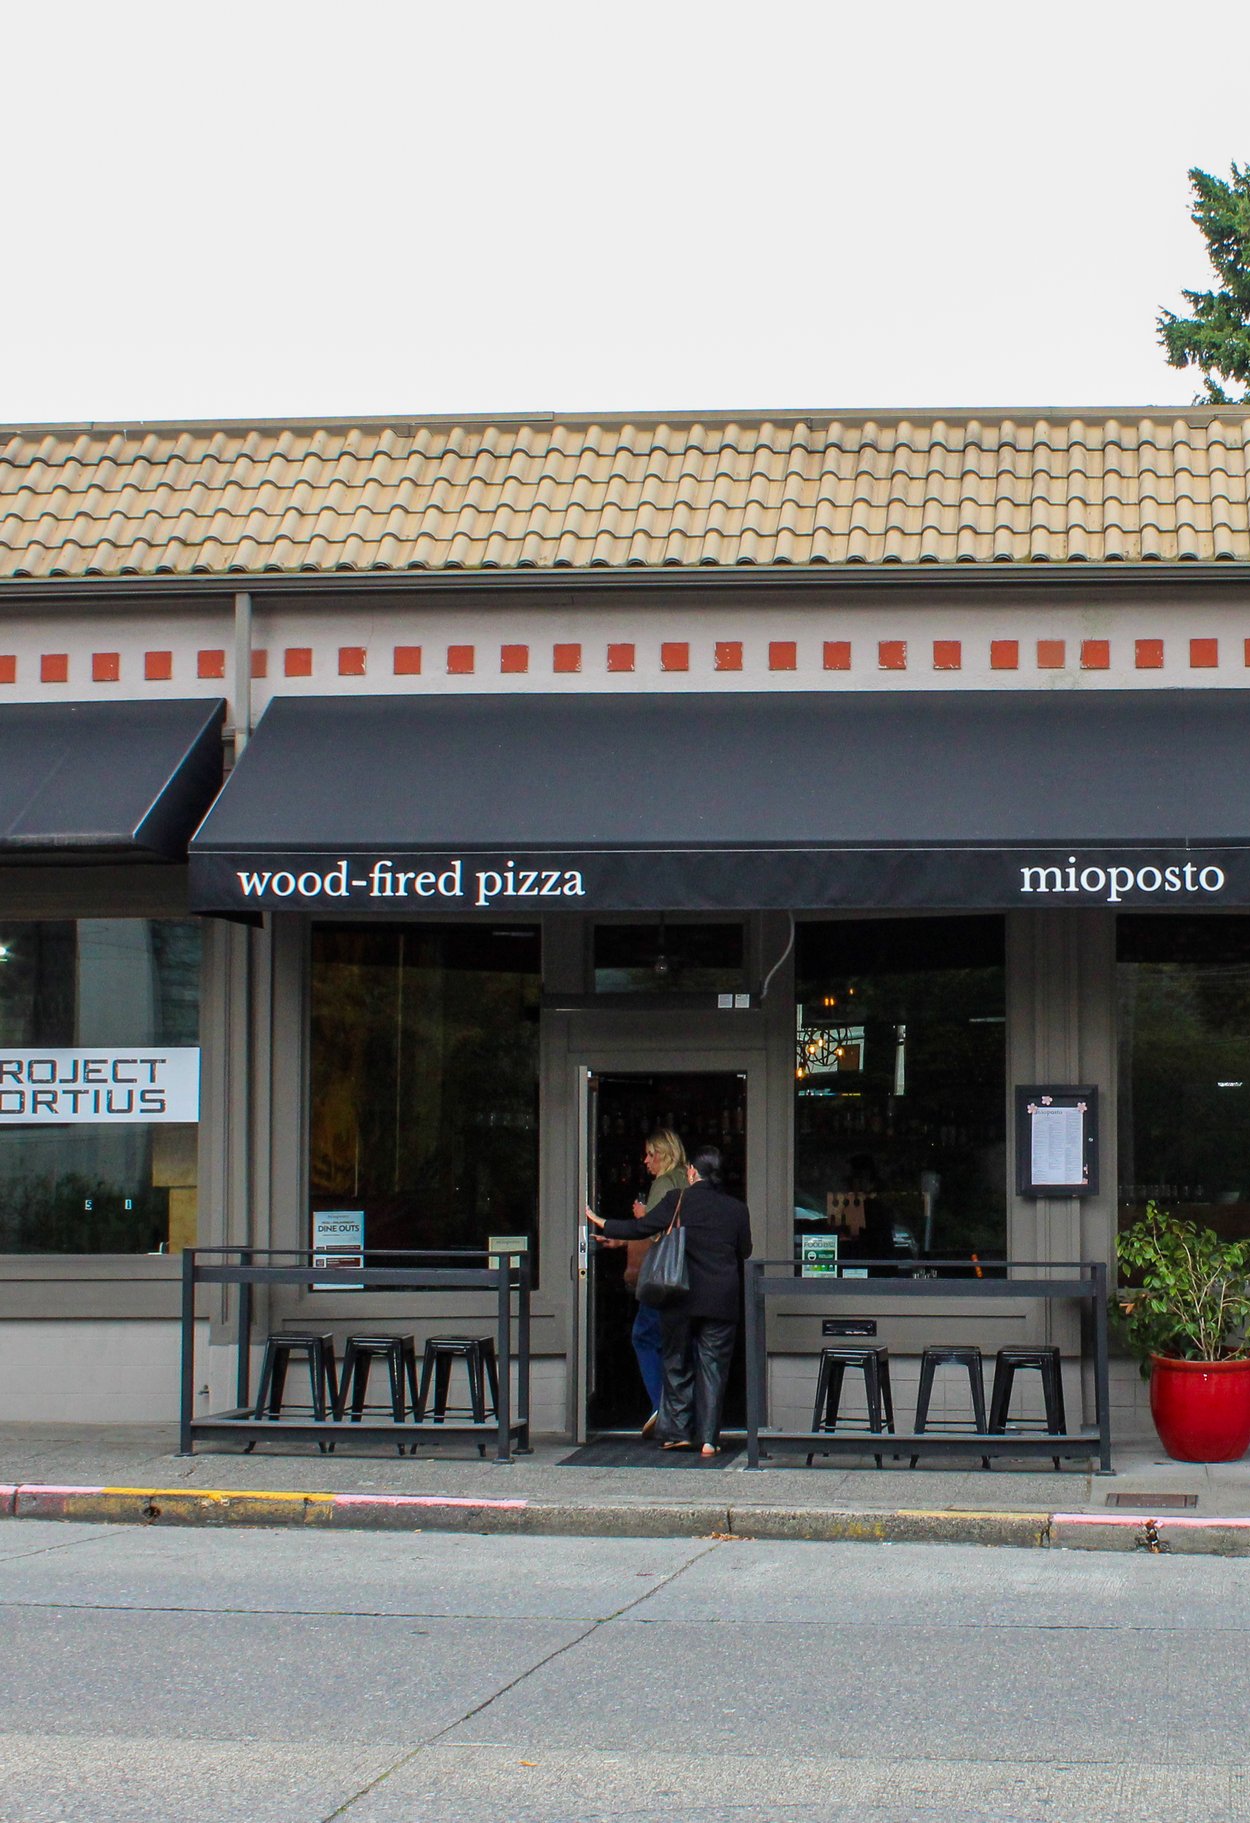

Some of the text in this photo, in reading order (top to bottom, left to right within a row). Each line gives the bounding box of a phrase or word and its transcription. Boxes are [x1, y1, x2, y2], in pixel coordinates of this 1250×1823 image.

[236, 860, 586, 906] wood-fired pizza
[1020, 856, 1225, 902] mioposto
[339, 1224, 360, 1232] OUTS
